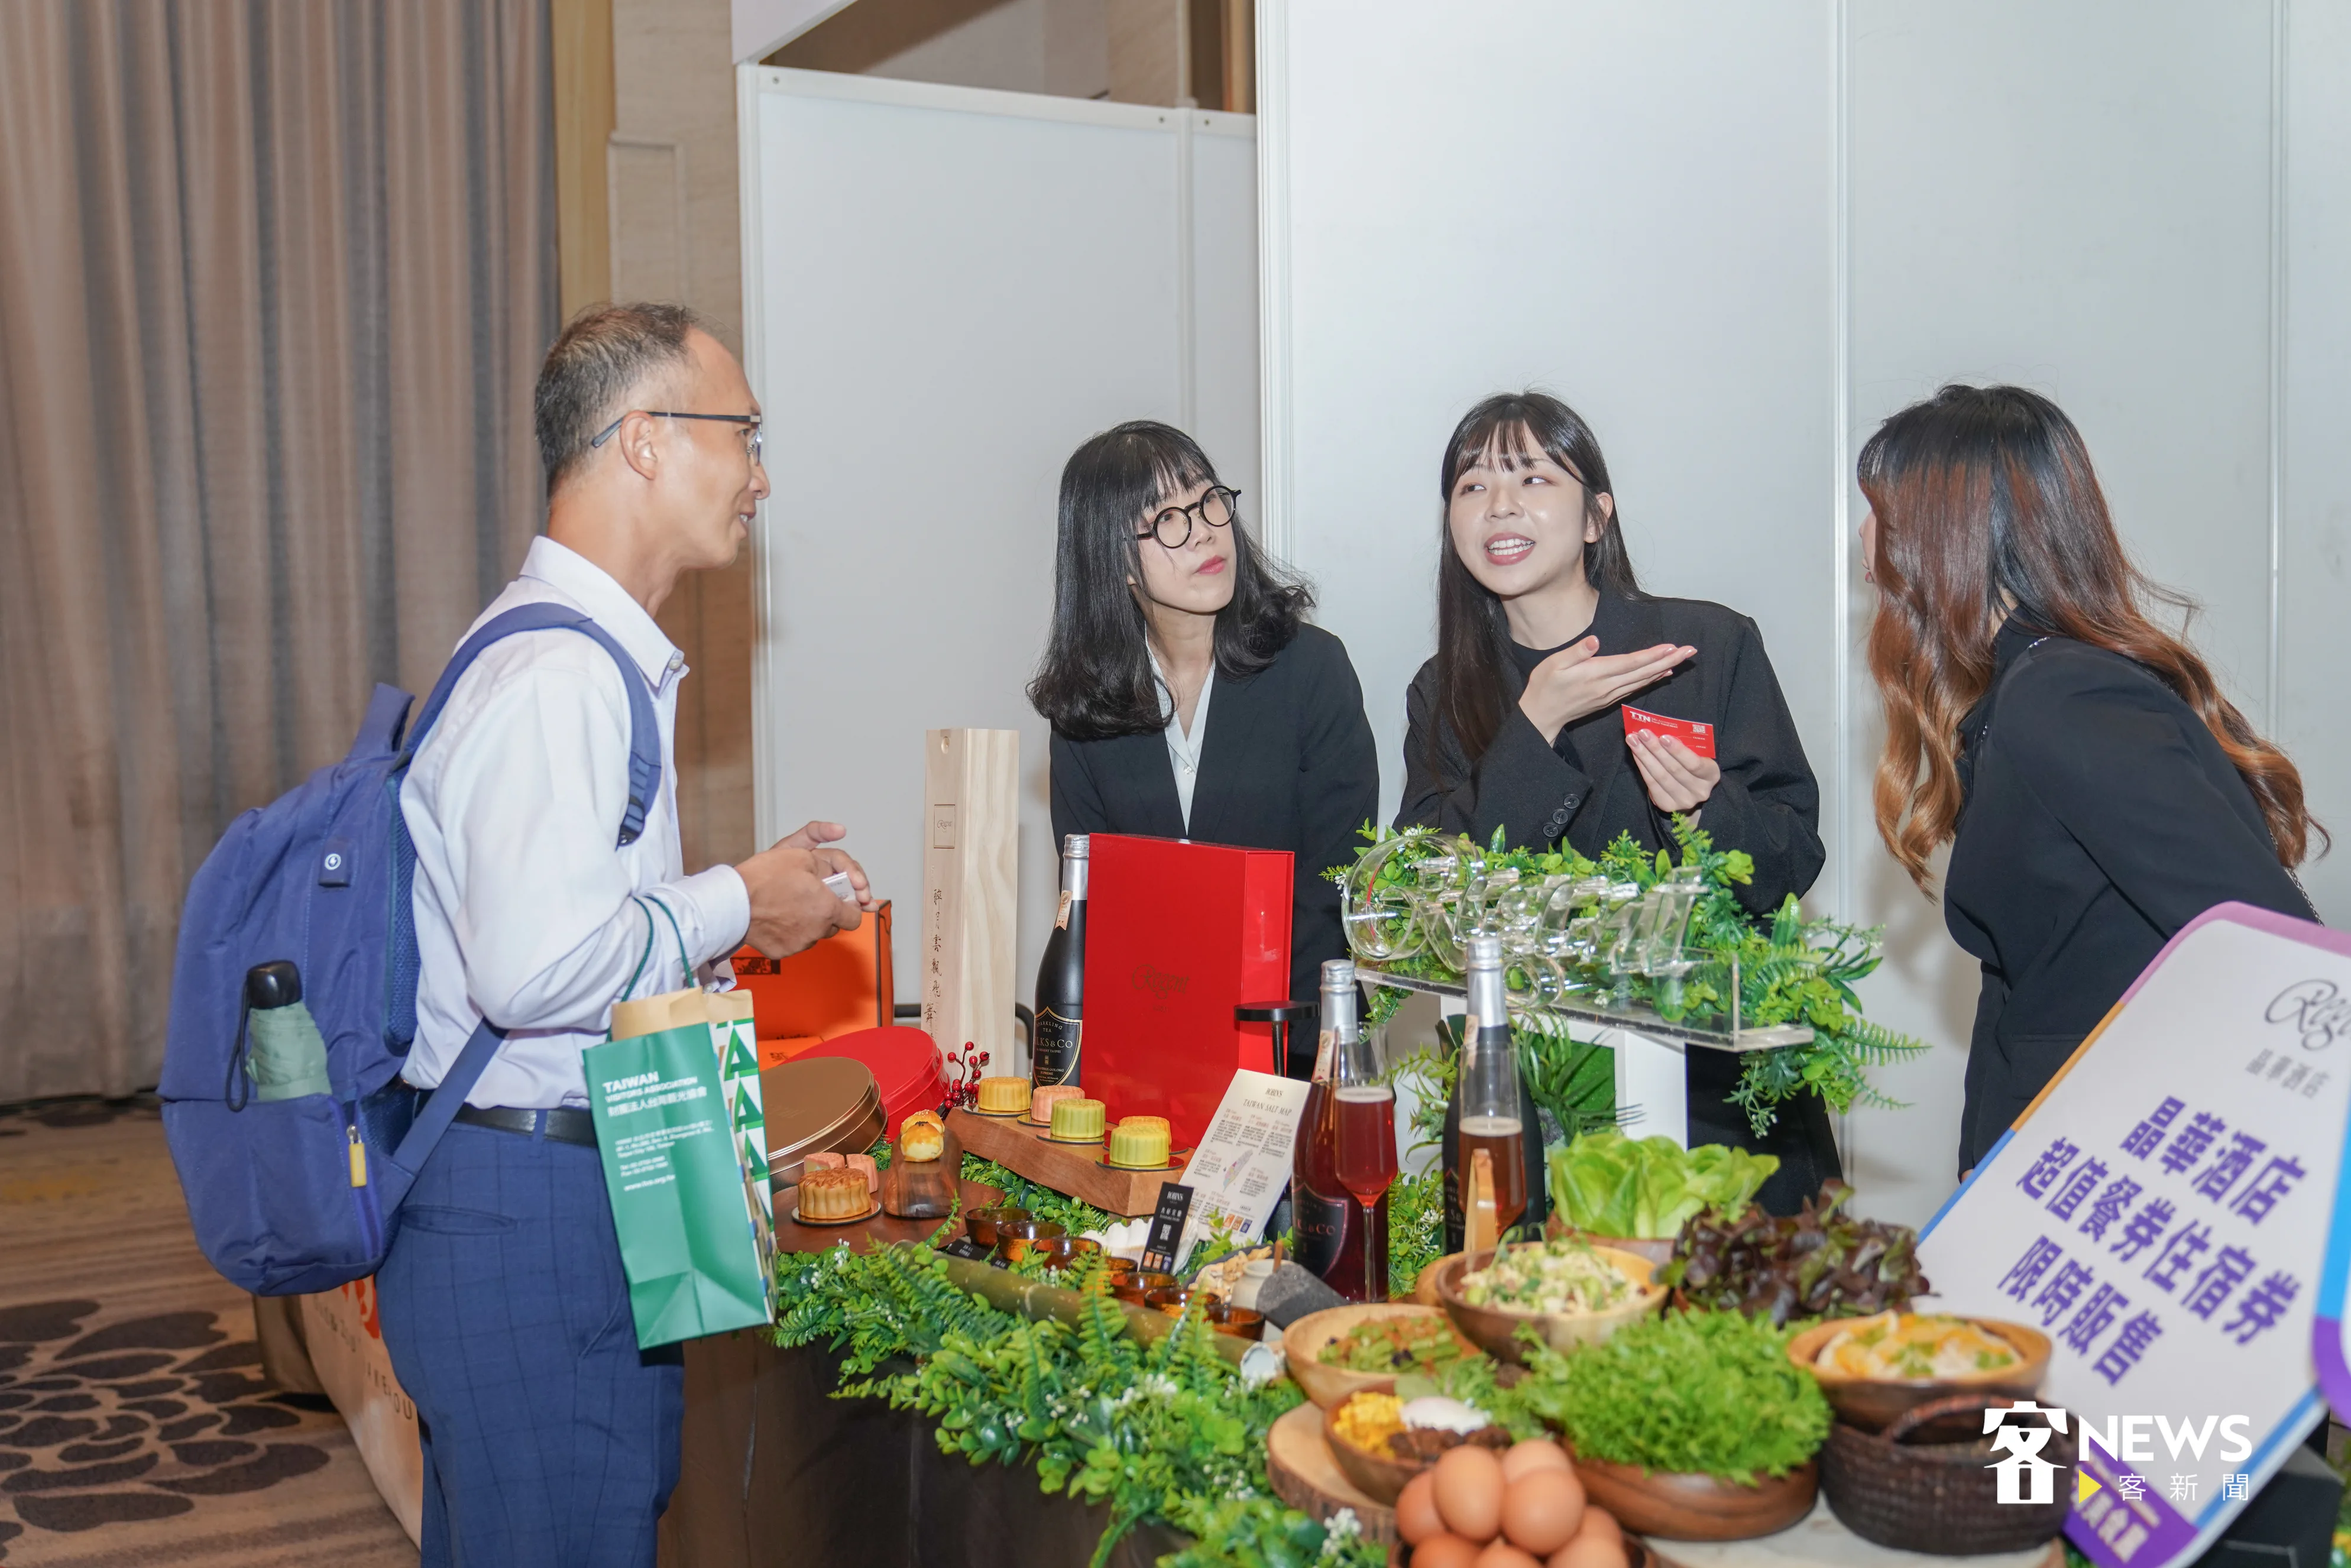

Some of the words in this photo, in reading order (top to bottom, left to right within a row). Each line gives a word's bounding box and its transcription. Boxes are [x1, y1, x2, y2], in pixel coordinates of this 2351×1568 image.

[1630, 711, 1651, 723] TTN
[1132, 964, 1190, 1000] Regent
[602, 1071, 659, 1094] TAIWAN
[605, 1088, 643, 1103] VISITORS
[643, 1076, 698, 1094] ASSOCIATION
[1243, 1099, 1264, 1110] TAIWAN
[1265, 1104, 1278, 1113] SALT
[1279, 1107, 1292, 1116] MAP
[2120, 1097, 2304, 1224] 晶華酒店
[2016, 1138, 2299, 1344] 超值餐券住宿券
[1999, 1236, 2162, 1385] 限時販售
